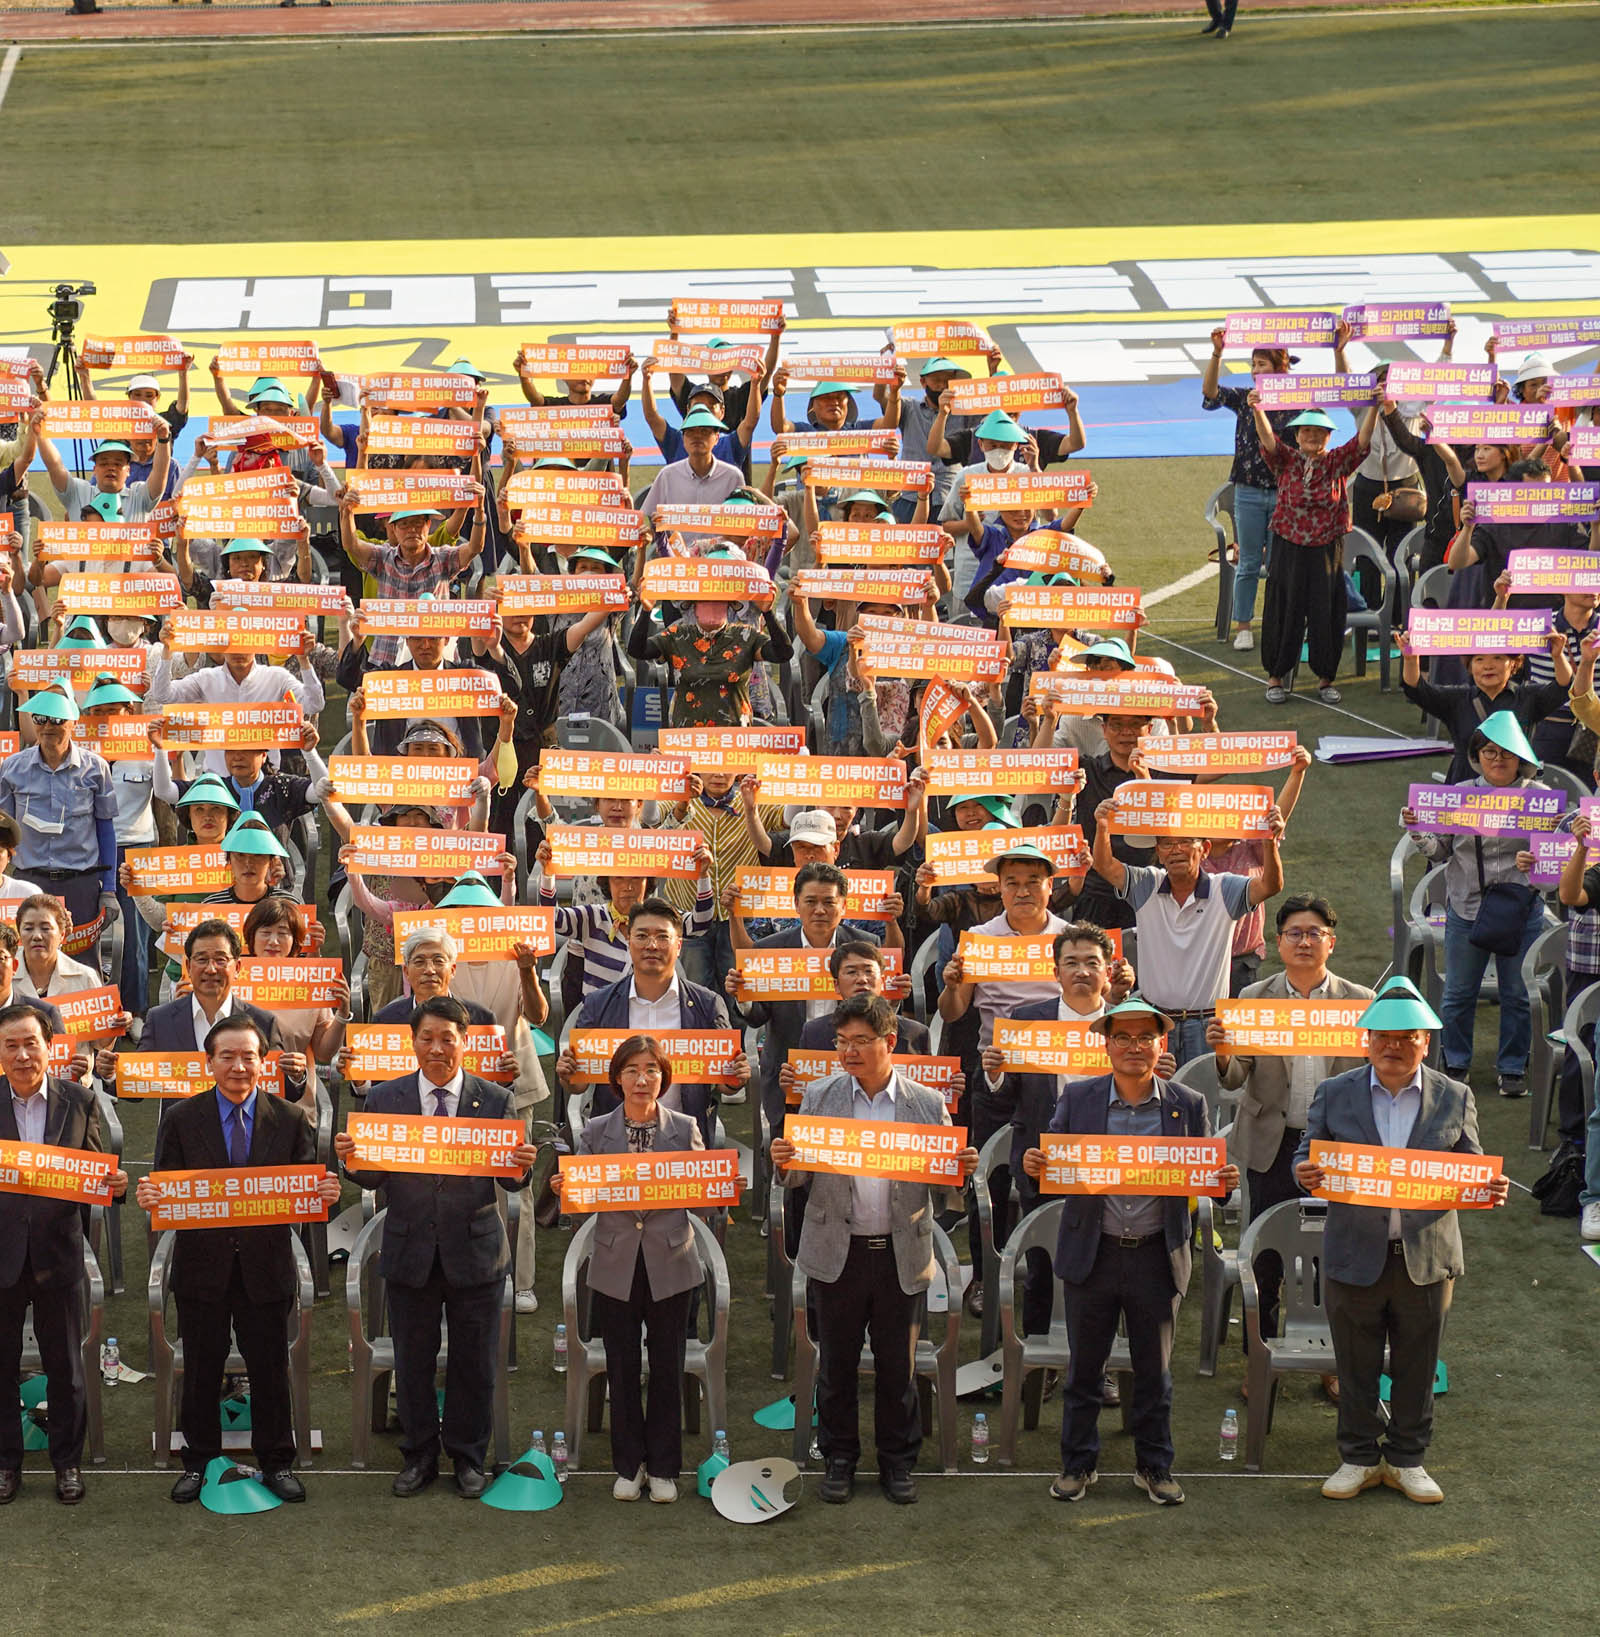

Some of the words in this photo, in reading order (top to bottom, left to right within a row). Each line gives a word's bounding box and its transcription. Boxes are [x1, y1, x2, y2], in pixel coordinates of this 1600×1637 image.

[675, 301, 701, 315] 34년
[730, 302, 779, 316] 이루어진다
[721, 316, 760, 329] 의과대학
[760, 316, 781, 330] 신설
[1262, 378, 1297, 390] 전남권
[1299, 376, 1346, 389] 의과대학
[1348, 375, 1371, 387] 신설
[1008, 590, 1036, 606] 34년
[1075, 591, 1138, 608] 이루어진다
[1008, 607, 1065, 622] 국립목포대
[1065, 607, 1113, 623] 의과대학
[1413, 617, 1454, 632] 전남권
[1457, 617, 1514, 632] 의과대학
[1517, 617, 1545, 632] 신설
[167, 710, 195, 726] 34년
[236, 708, 299, 726] 이루어진다
[167, 728, 225, 743] 국립목포대
[227, 727, 275, 742] 의과대학
[275, 726, 300, 742] 신설
[544, 755, 574, 772] 34년
[617, 758, 685, 775] 이루어진다
[542, 773, 606, 791] 국립목포대
[607, 775, 659, 793] 의과대학
[659, 777, 686, 793] 신설
[1195, 791, 1269, 812] 이루어진다
[1417, 791, 1462, 809] 전남권
[1464, 794, 1526, 812] 의과대학
[1528, 797, 1559, 813] 신설
[1113, 806, 1182, 828] 국립목포대
[1183, 812, 1241, 830] 의과대학
[1483, 814, 1516, 829] 마침표도
[1517, 816, 1555, 831] 국립목포
[790, 1124, 826, 1145] 34년
[878, 1131, 959, 1155] 이루어진다
[865, 1152, 927, 1174] 의과대학
[928, 1155, 962, 1176] 신설
[1046, 1143, 1082, 1163] 34년
[1136, 1144, 1219, 1166] 이루어진다
[567, 1163, 602, 1184] 34년
[654, 1158, 733, 1180] 이루어진다
[1044, 1165, 1121, 1185] 국립목포대
[1124, 1168, 1187, 1187] 의과대학
[242, 1173, 319, 1196] 이루어진다
[566, 1184, 641, 1205] 국립목포대
[643, 1182, 704, 1201] 의과대학
[705, 1180, 735, 1199] 신설
[156, 1199, 230, 1221] 국립목포대
[232, 1197, 292, 1217] 의과대학
[293, 1196, 323, 1215] 신설
